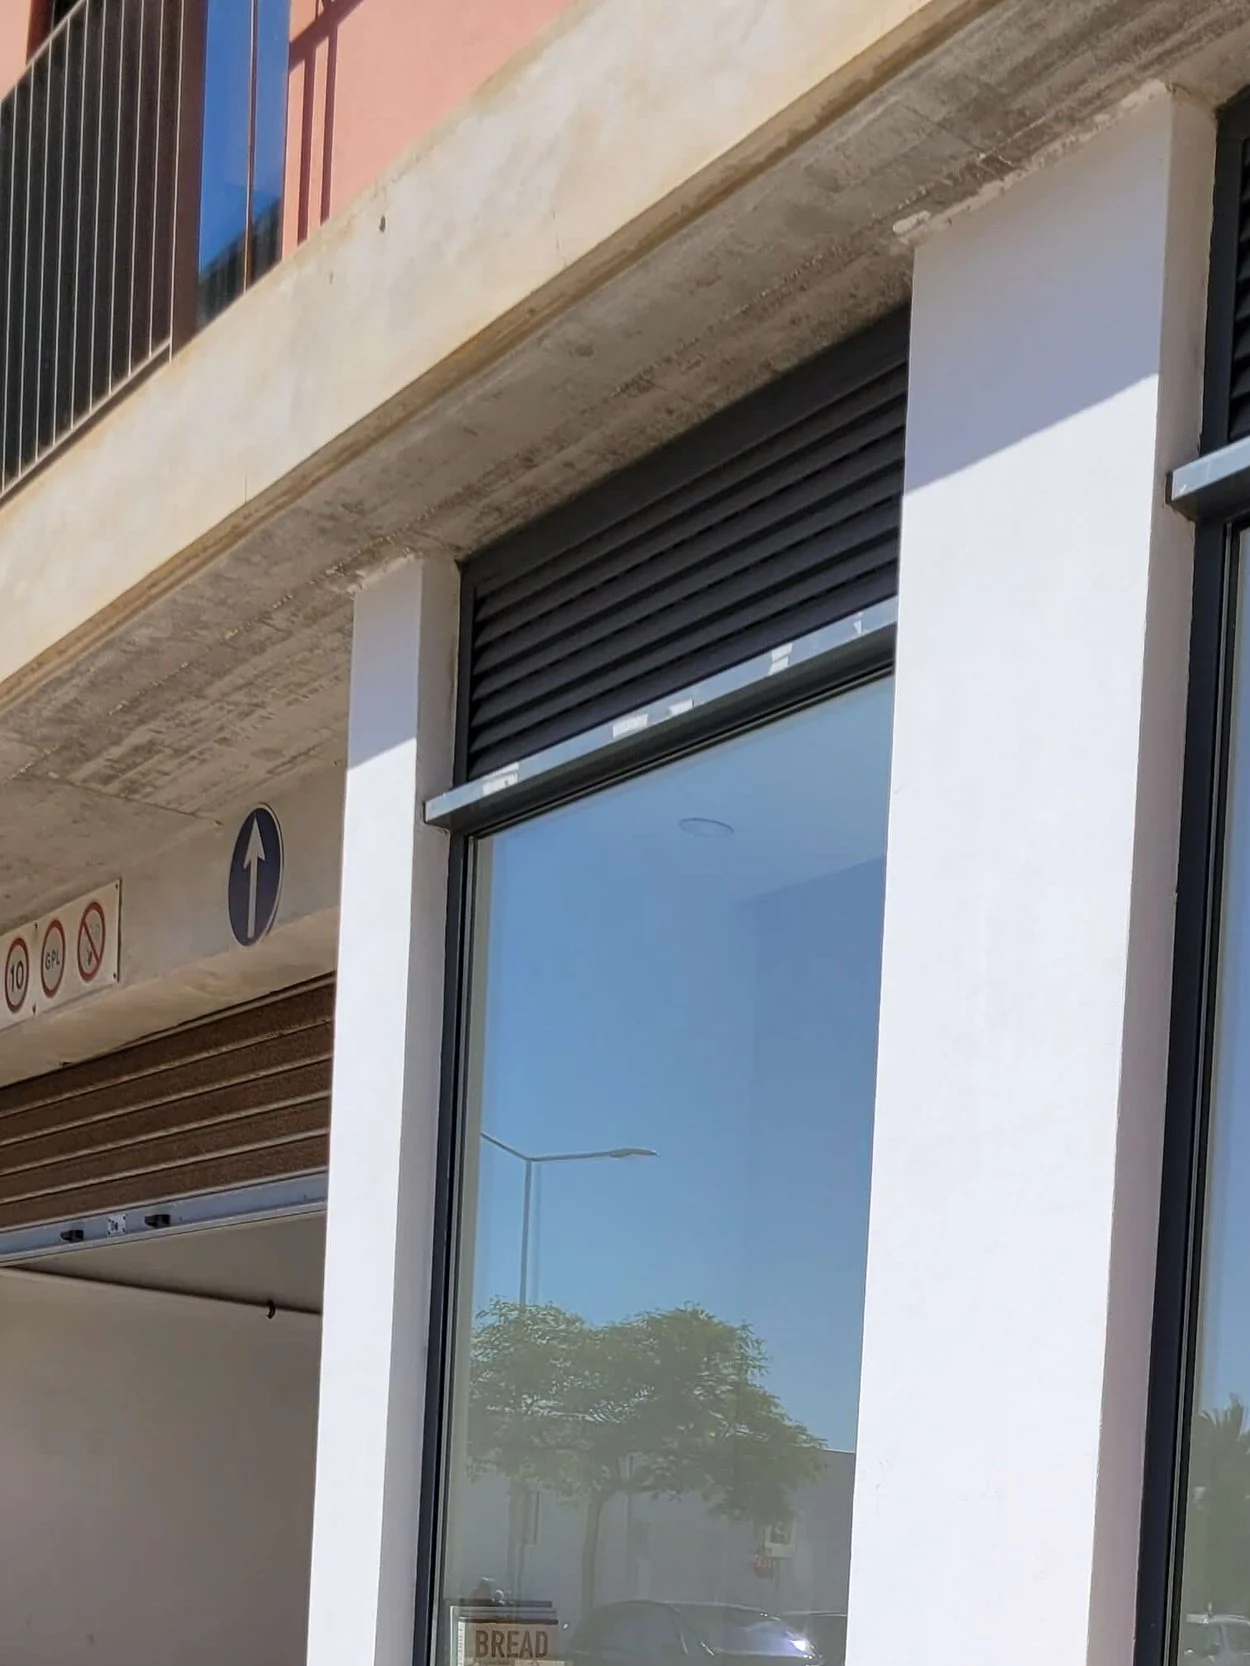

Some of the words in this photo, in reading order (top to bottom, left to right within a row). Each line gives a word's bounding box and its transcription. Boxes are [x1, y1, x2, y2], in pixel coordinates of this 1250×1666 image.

[45, 949, 60, 971] GPL
[10, 960, 24, 993] 10
[475, 1629, 549, 1659] BREAD
